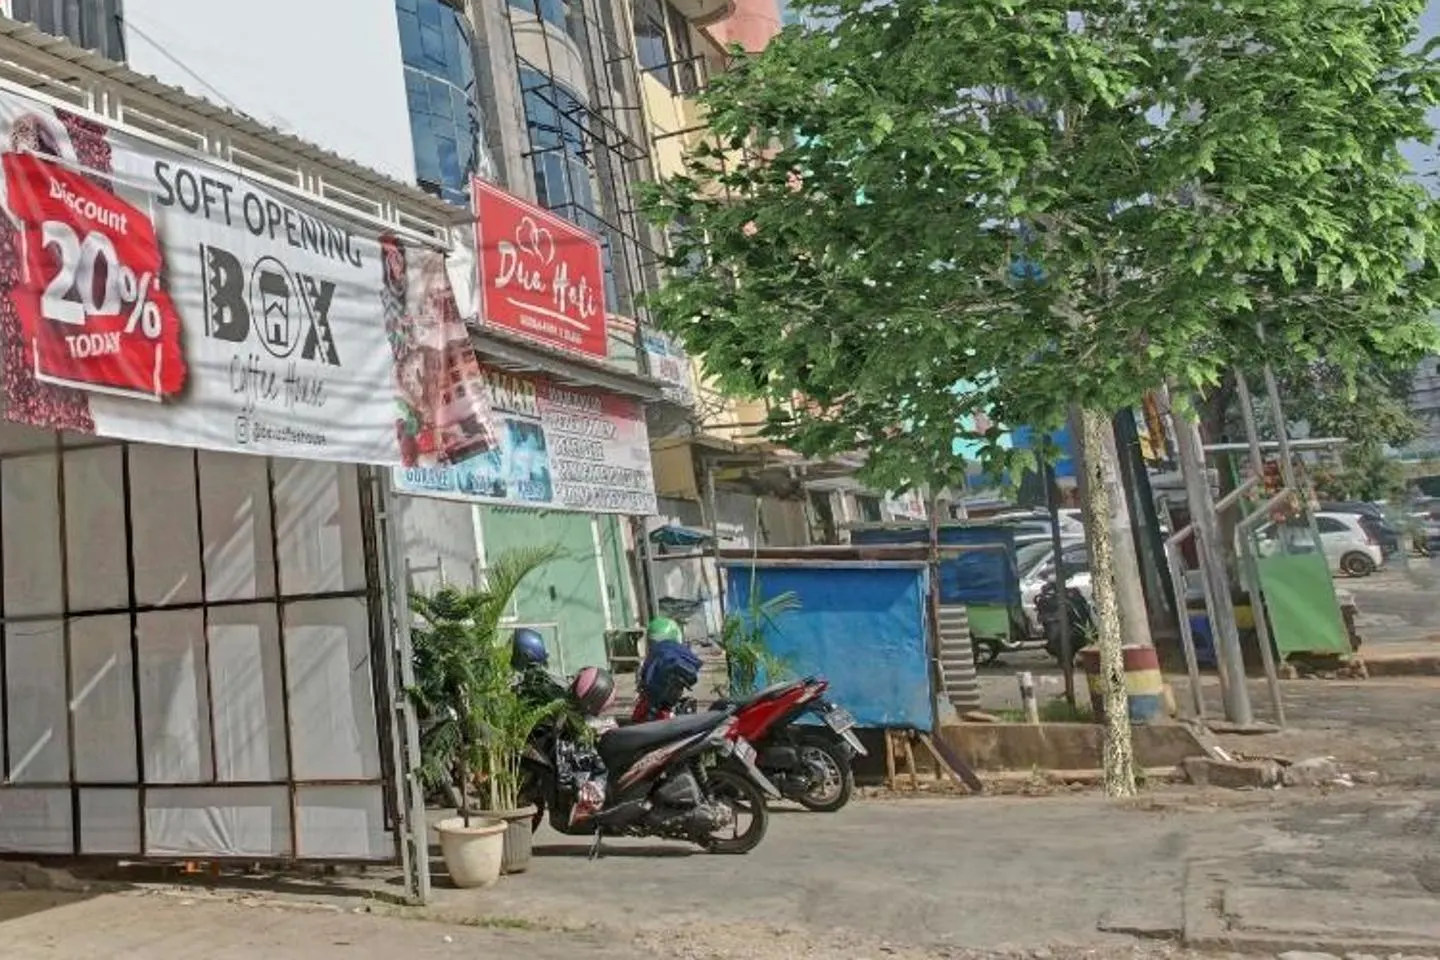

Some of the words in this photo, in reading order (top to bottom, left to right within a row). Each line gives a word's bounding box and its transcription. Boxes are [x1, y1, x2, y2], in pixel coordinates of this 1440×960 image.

[49, 176, 128, 235] Discount
[154, 161, 233, 226] SOFT
[243, 192, 363, 268] OPENING
[40, 220, 162, 338] 20%
[199, 243, 341, 367] BOX
[495, 239, 547, 293] Dua
[553, 260, 596, 319] Hati
[65, 331, 122, 359] TODAY
